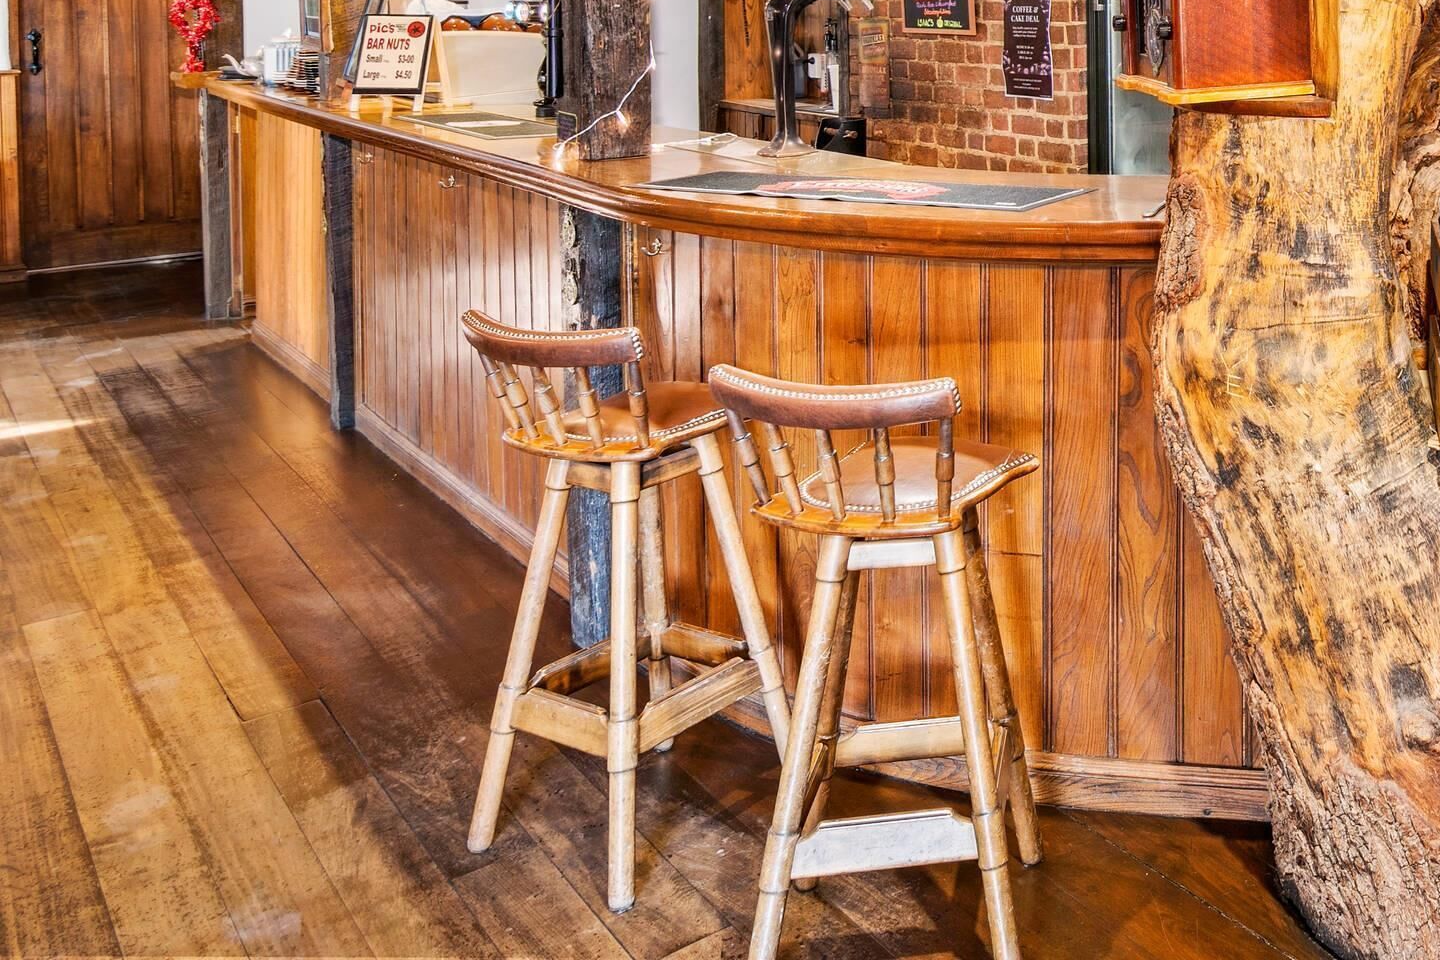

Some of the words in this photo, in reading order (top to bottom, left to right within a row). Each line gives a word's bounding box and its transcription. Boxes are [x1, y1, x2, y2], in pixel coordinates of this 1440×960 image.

[1012, 5, 1033, 14] COFFEE
[1033, 6, 1039, 14] &
[1010, 15, 1025, 23] CAKE
[1025, 15, 1040, 23] DEAL
[366, 38, 385, 50] BAR
[386, 38, 411, 50] NUTS
[366, 53, 383, 63] Small
[362, 69, 380, 80] Large
